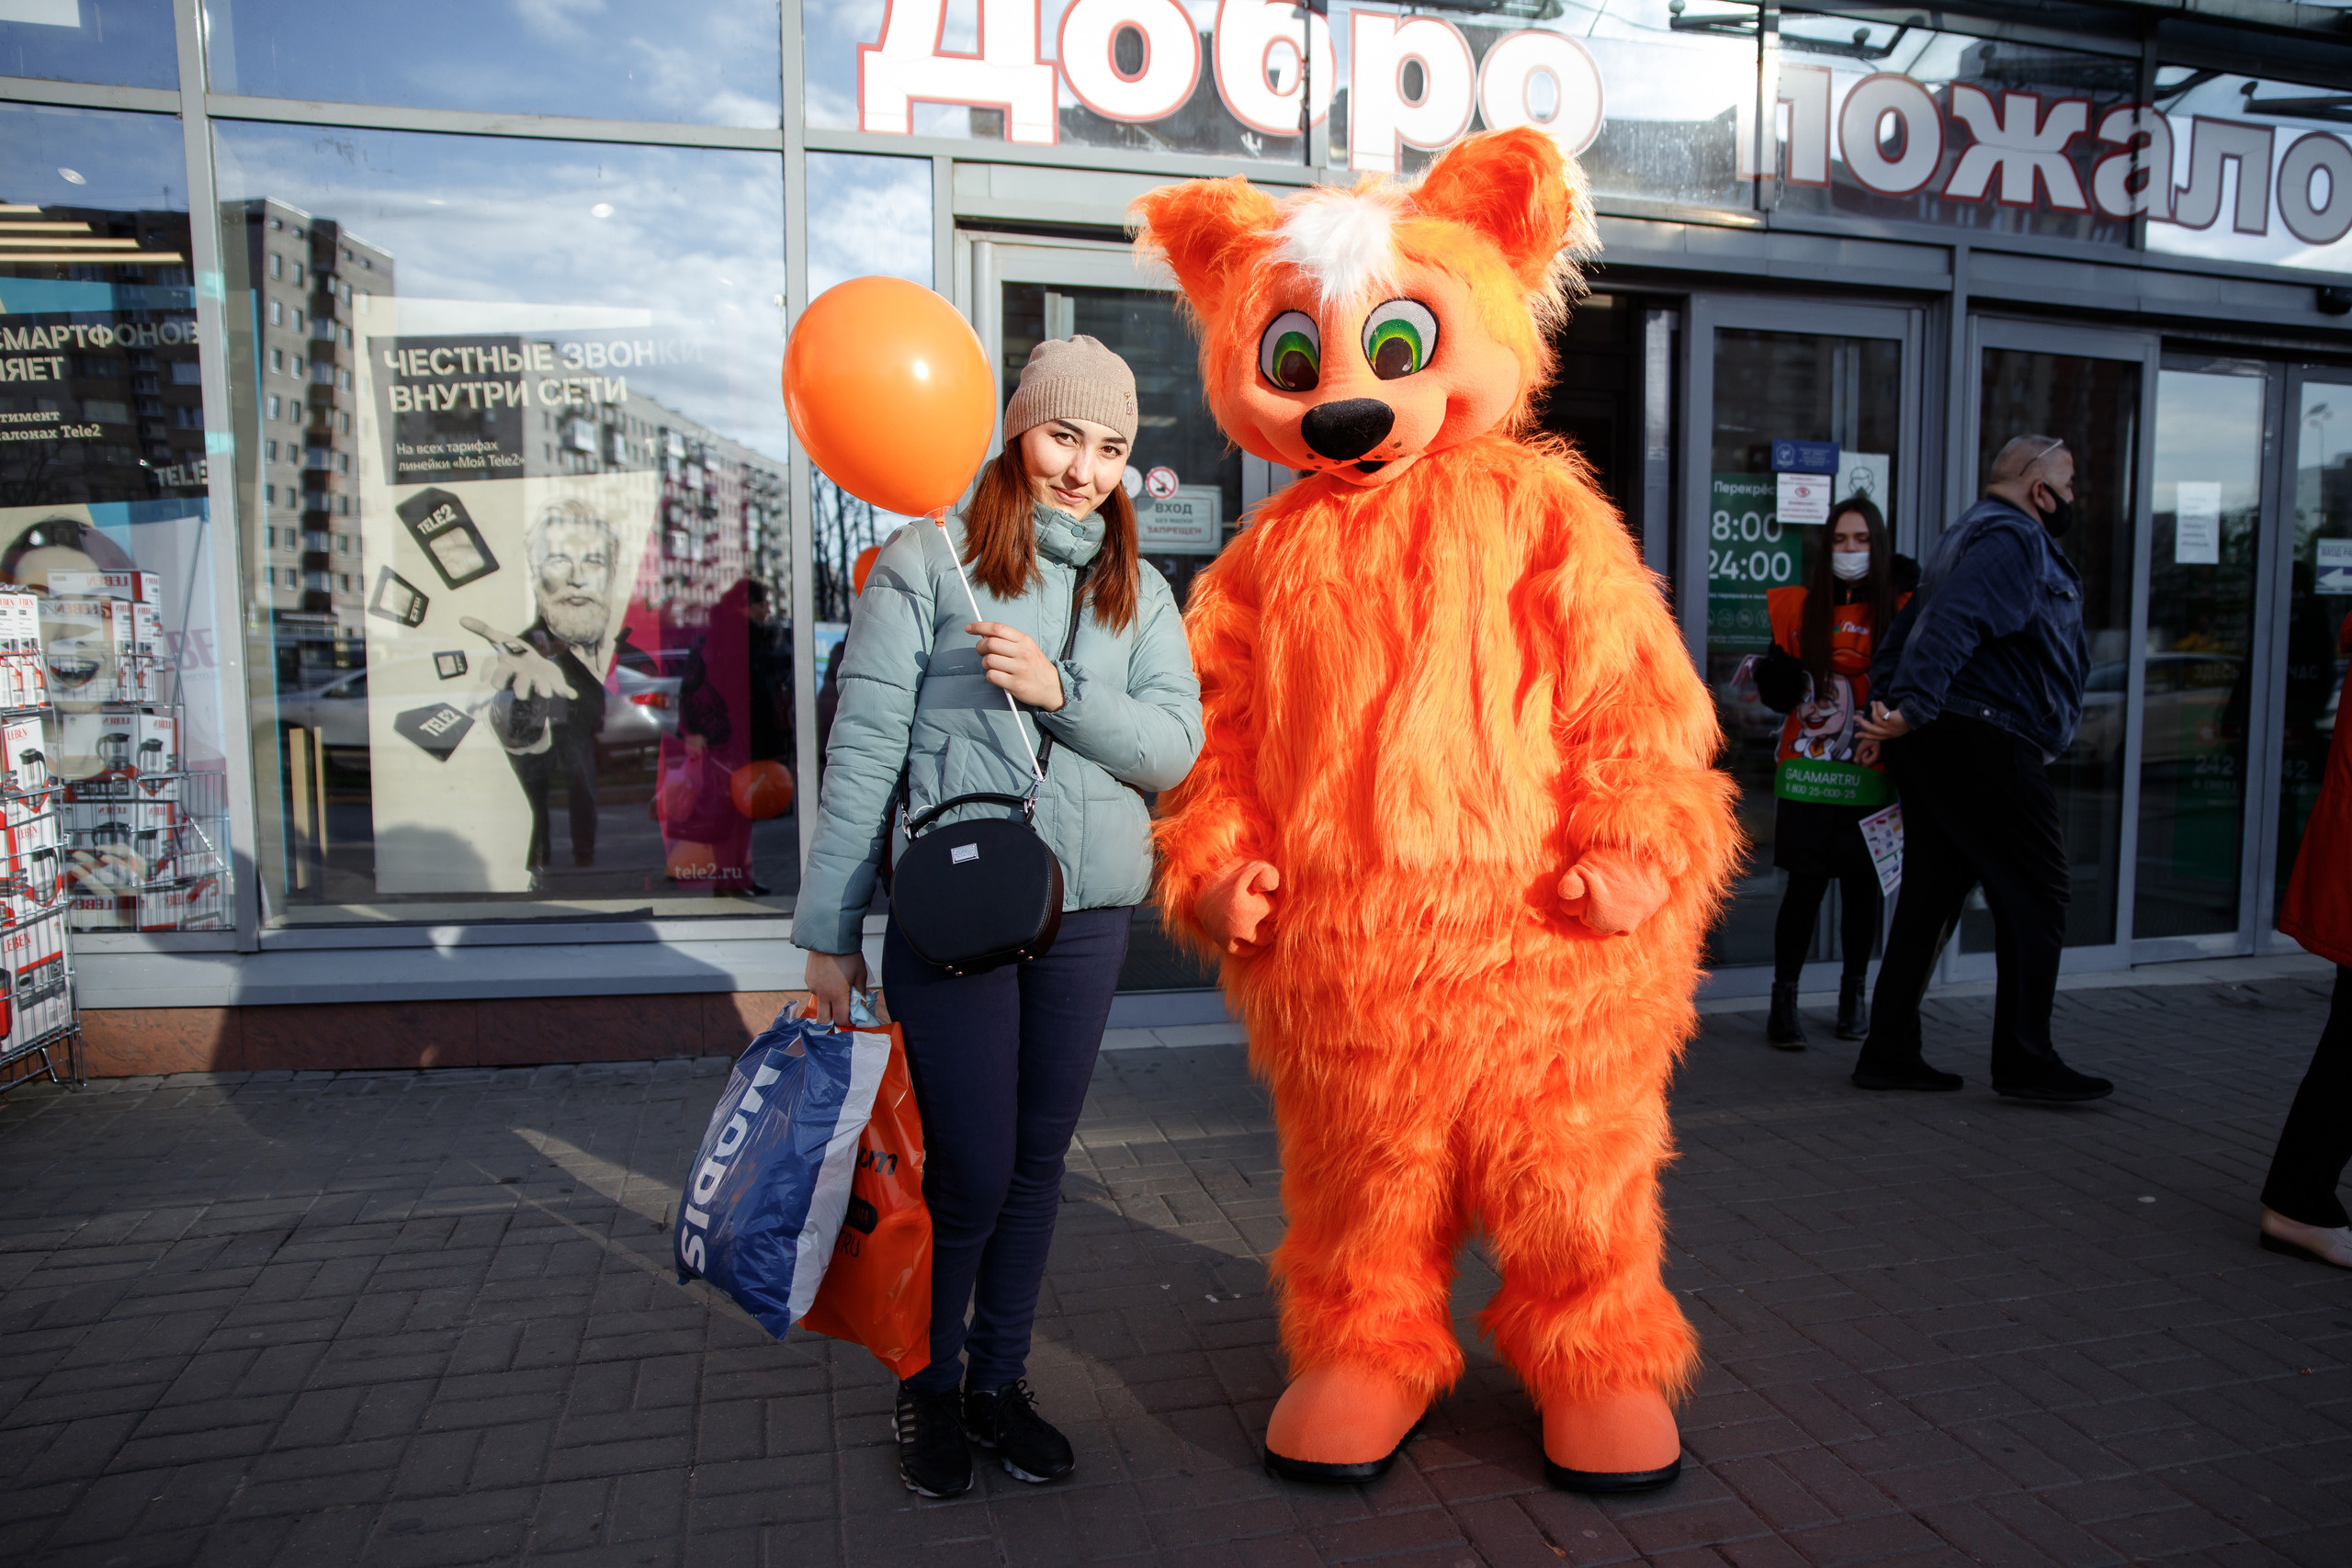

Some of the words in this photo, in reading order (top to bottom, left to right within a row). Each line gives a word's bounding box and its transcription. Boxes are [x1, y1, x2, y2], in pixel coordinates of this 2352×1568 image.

[856, 0, 1605, 174] Добро
[383, 344, 554, 377] ЧЕСТНЫЕ
[561, 338, 706, 369] ЗВОНКИ
[388, 379, 530, 412] ВНУТРИ
[537, 376, 628, 406] СЕТИ
[0, 426, 58, 441] алонах
[61, 423, 102, 438] Tele2
[396, 443, 413, 456] На
[416, 444, 443, 455] всех
[445, 438, 499, 457] тарифах
[399, 458, 450, 472] линейки
[416, 503, 458, 536] TELE2
[1155, 503, 1193, 515] ВХОД
[1712, 510, 1783, 543] 8:00
[1709, 550, 1792, 581] 24:00
[7, 728, 28, 741] LEBEN
[419, 707, 461, 737] TELE2
[1785, 768, 1860, 786] GALAMART.RU
[674, 863, 743, 879] tele2.ru
[681, 1066, 782, 1274] MODIS
